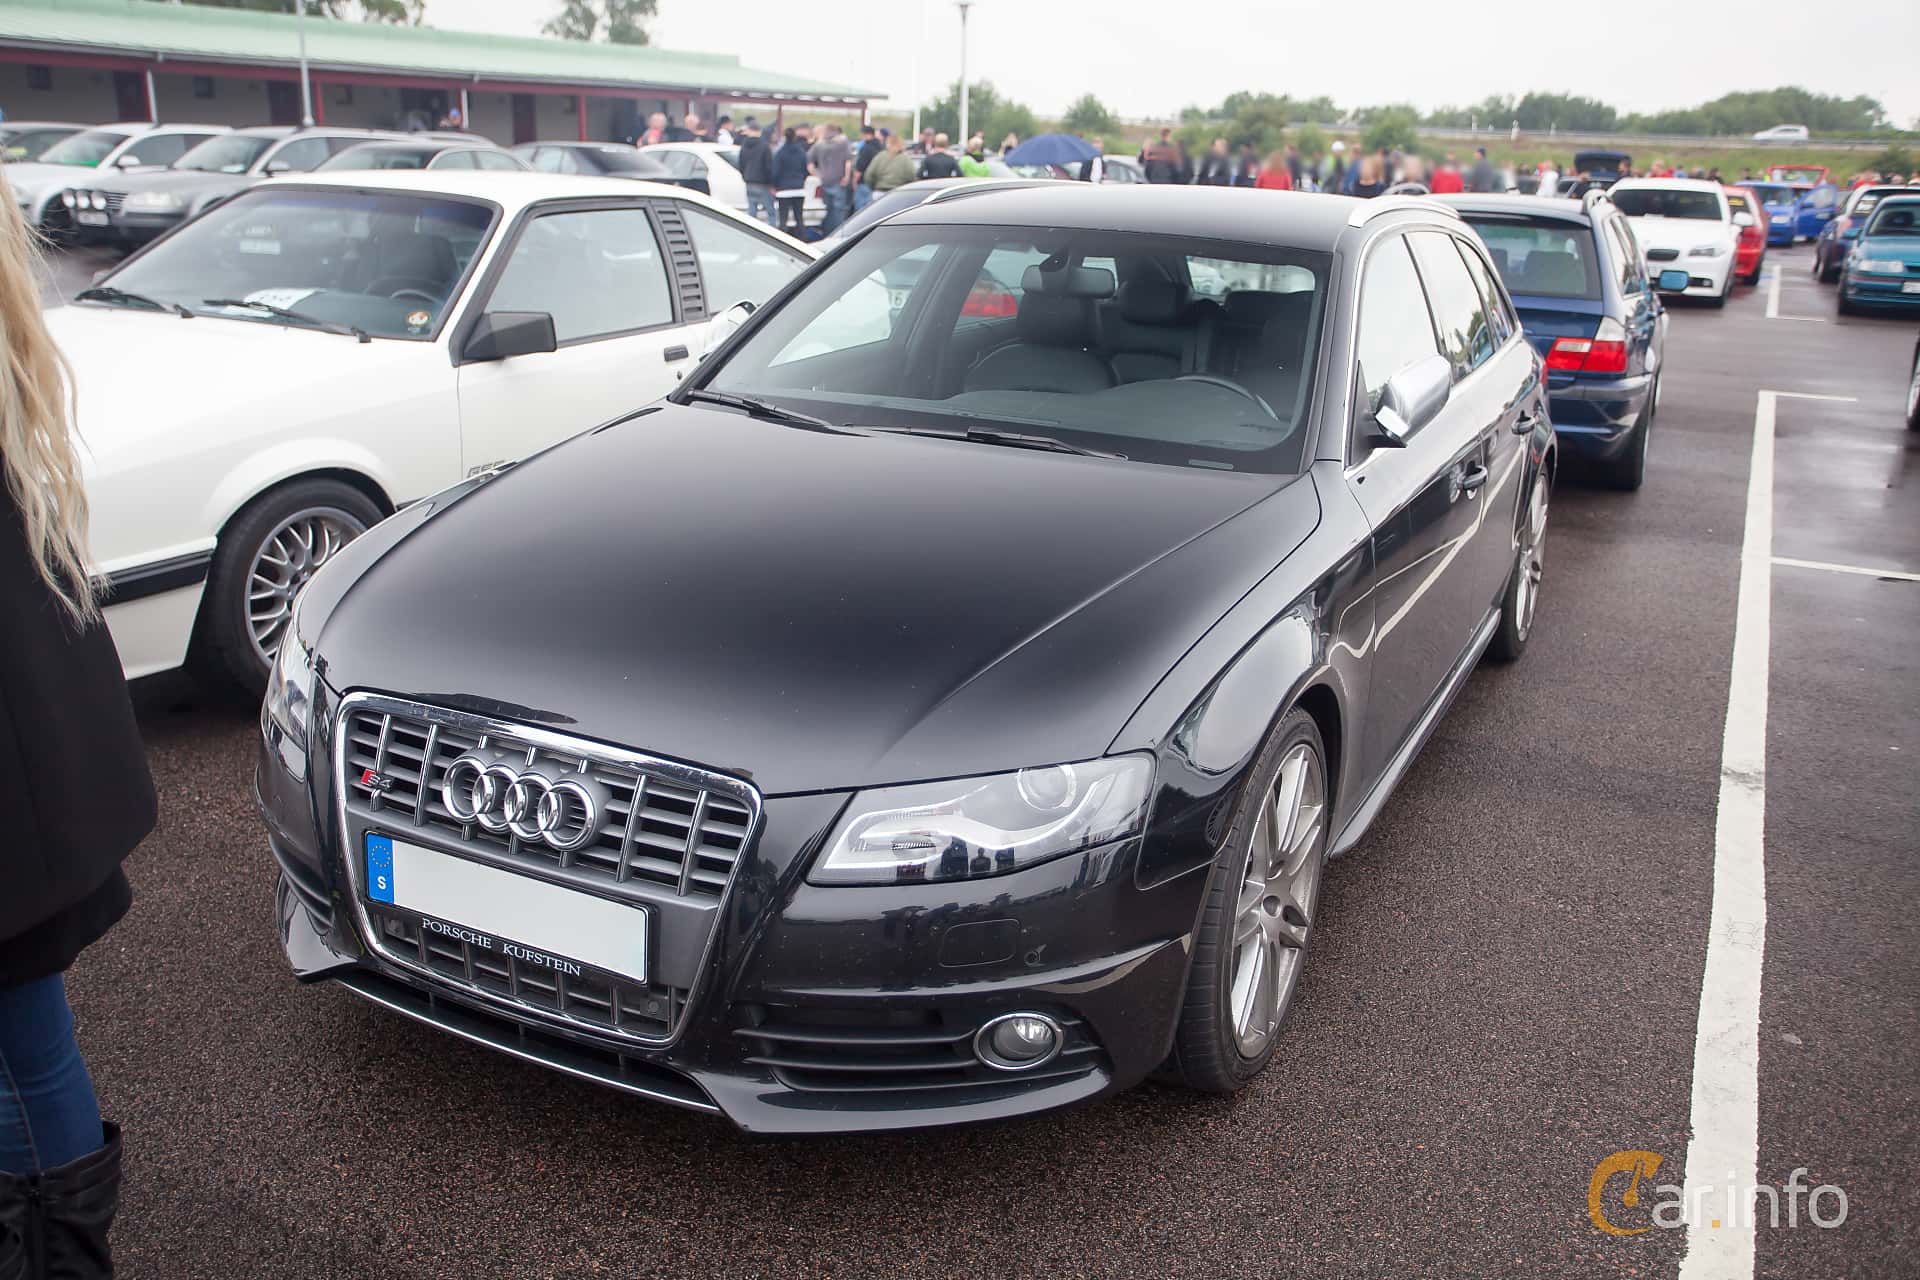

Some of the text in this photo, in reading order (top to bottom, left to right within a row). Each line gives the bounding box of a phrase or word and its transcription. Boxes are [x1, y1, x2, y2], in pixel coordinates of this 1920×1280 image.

[362, 769, 392, 791] S4
[377, 875, 387, 890] S
[422, 917, 581, 976] PORSCHE KUFSTEIN
